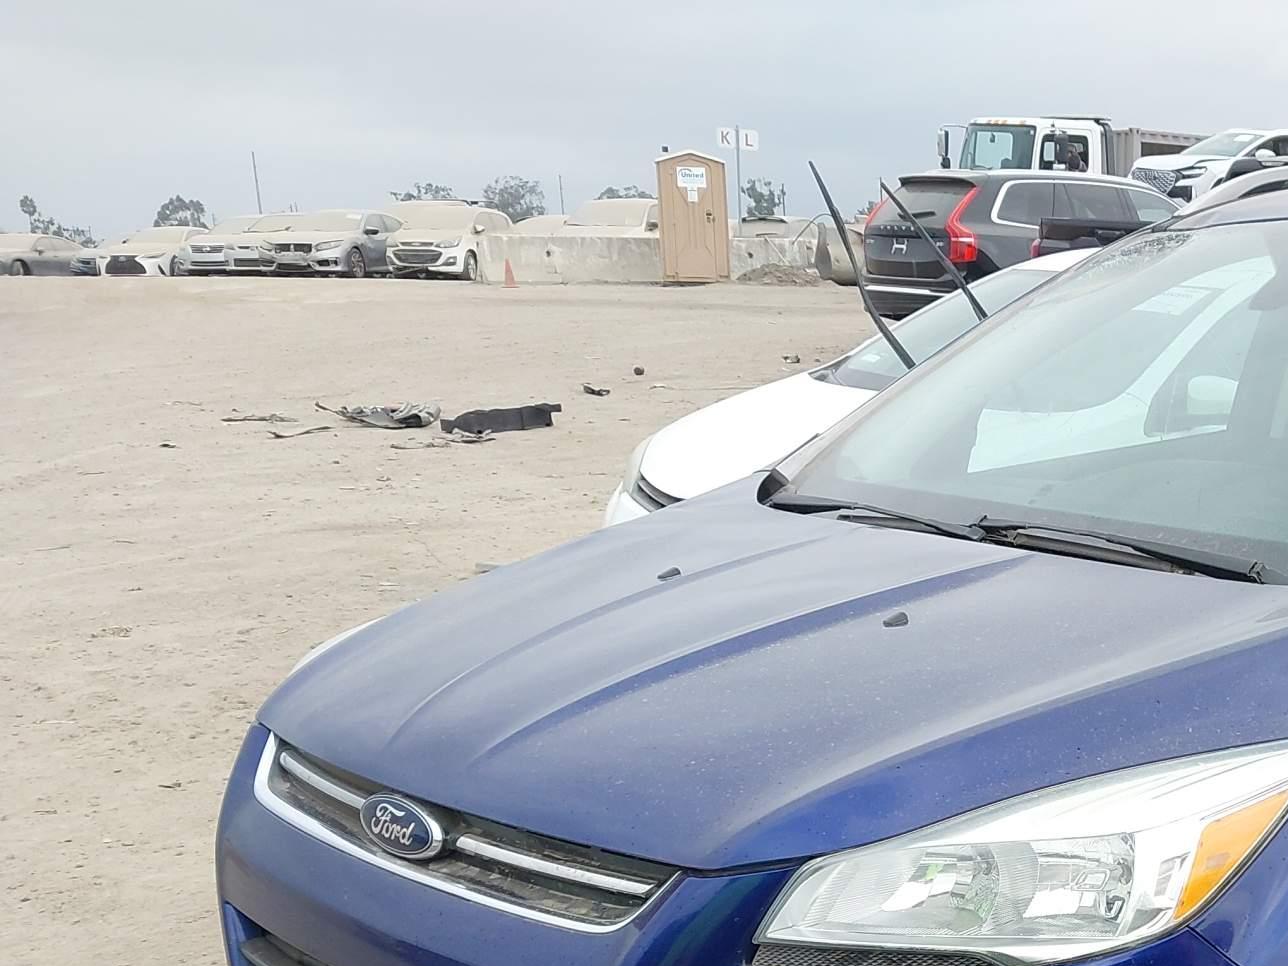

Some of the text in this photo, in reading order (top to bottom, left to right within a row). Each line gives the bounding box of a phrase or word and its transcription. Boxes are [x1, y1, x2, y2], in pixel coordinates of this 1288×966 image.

[721, 131, 731, 145] K
[745, 133, 754, 147] L
[681, 171, 704, 179] United
[371, 803, 415, 845] Ford
